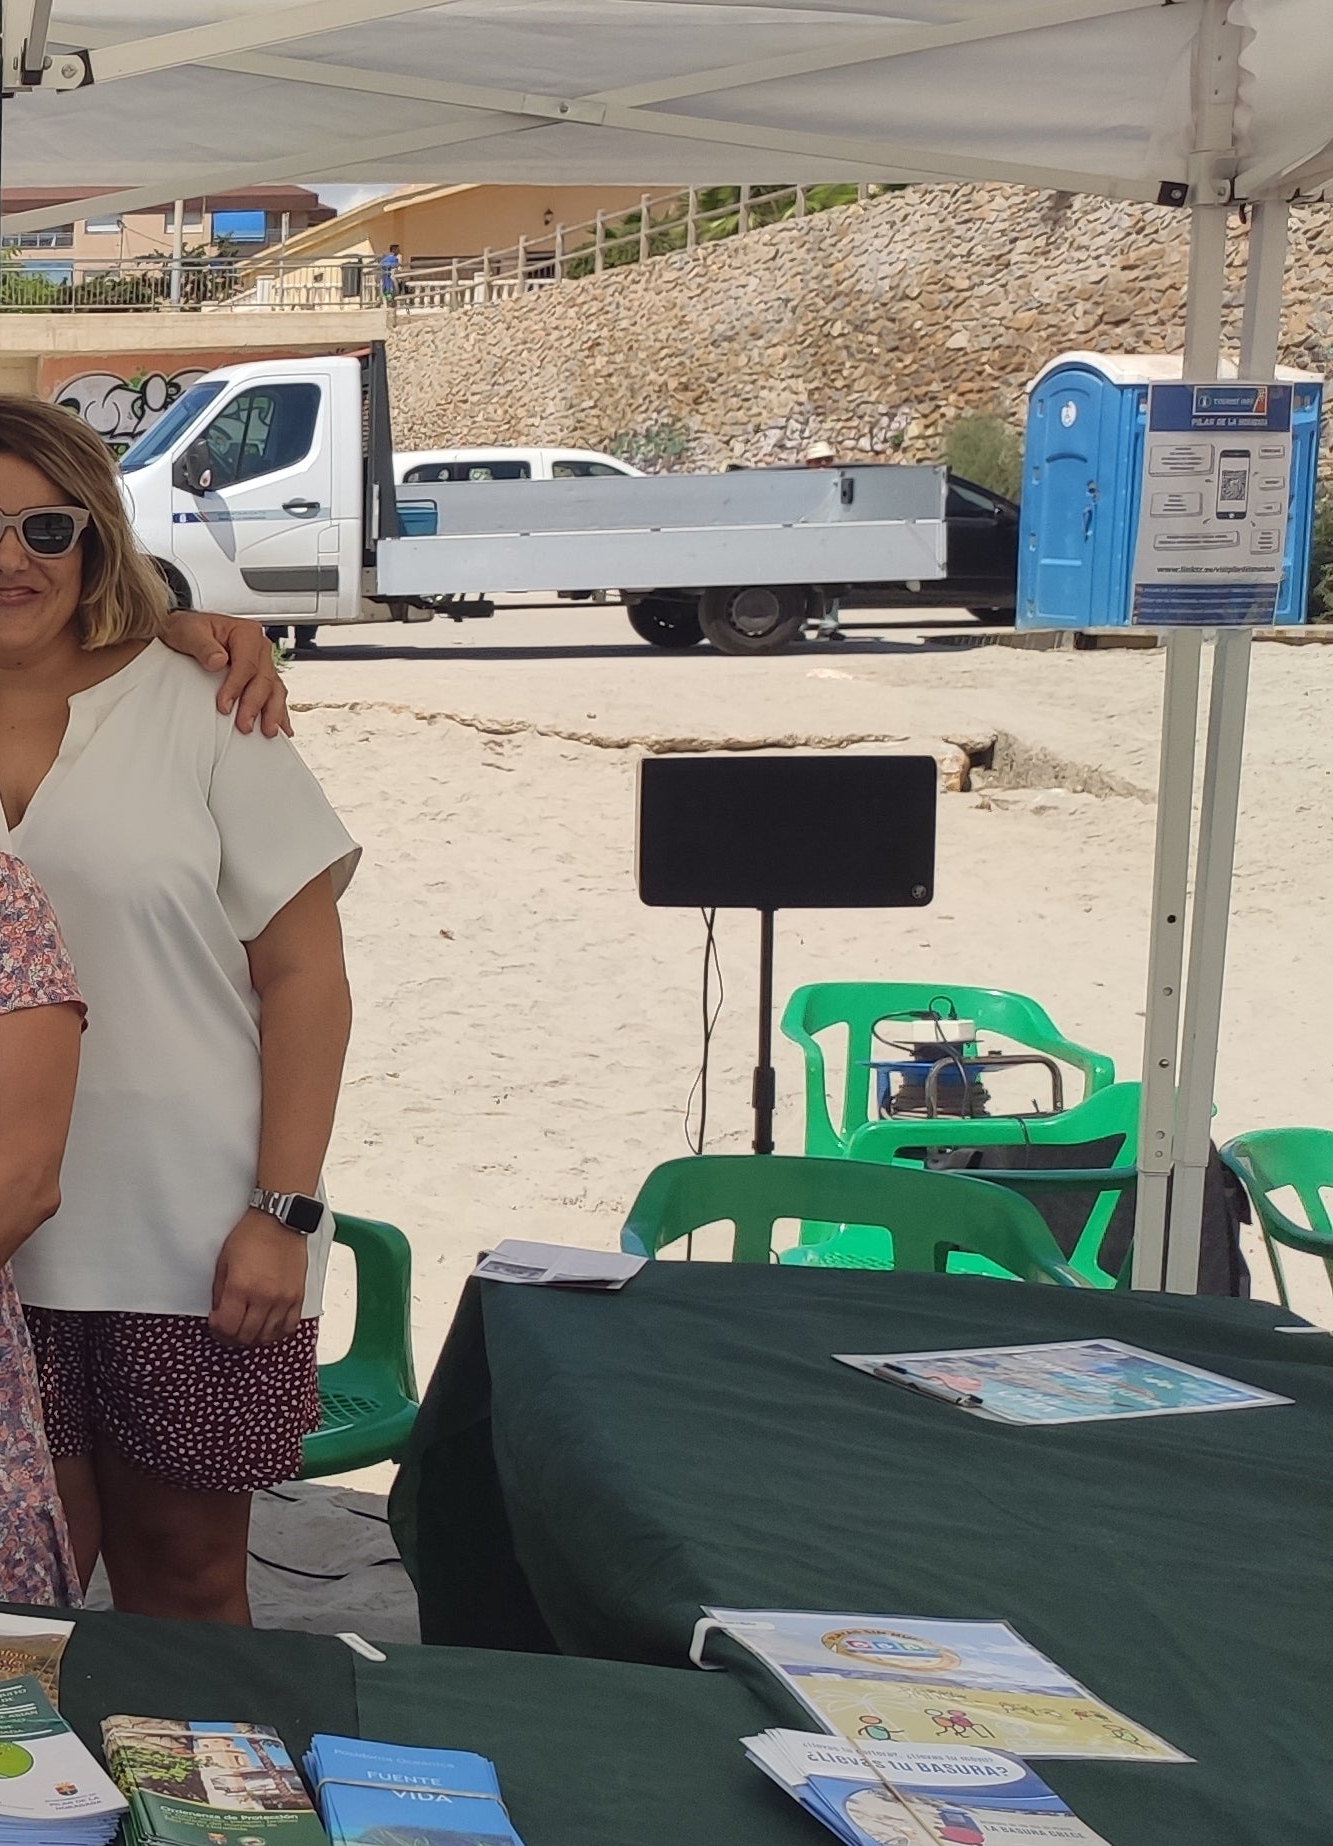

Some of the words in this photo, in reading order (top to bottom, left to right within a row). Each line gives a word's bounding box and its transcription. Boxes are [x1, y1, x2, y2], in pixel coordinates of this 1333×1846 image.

[807, 1751, 886, 1769] ¿Llevas
[888, 1761, 912, 1771] tu
[915, 1762, 1009, 1777] BASURA?
[366, 1771, 443, 1786] FUENTE
[391, 1790, 453, 1803] VIDA
[159, 1805, 221, 1820] Ordenanza
[240, 1813, 299, 1822] Protección
[1001, 1826, 1047, 1837] BASURA
